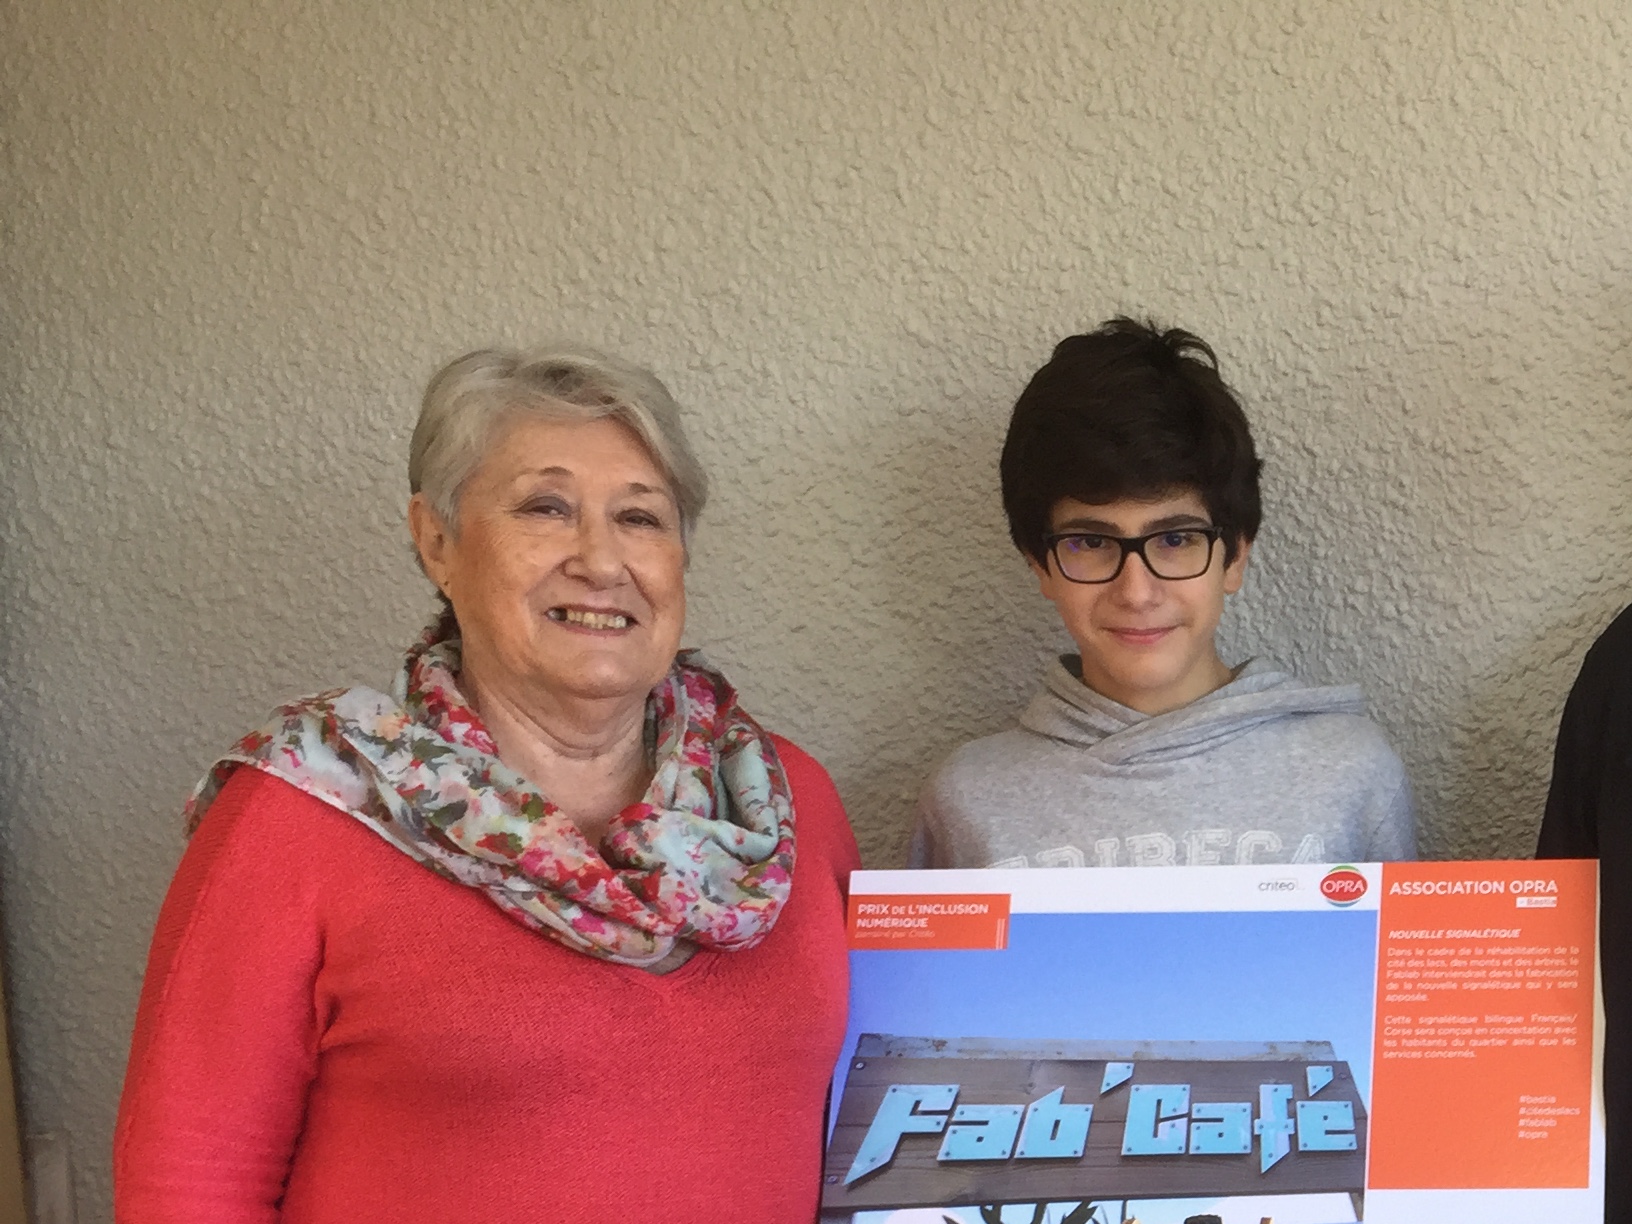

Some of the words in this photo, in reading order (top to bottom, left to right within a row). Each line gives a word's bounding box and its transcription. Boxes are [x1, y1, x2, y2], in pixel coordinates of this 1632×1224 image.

[986, 828, 1325, 868] IBECA
[1322, 880, 1365, 894] OPRA
[1389, 880, 1505, 896] ASSOCIATION
[1509, 880, 1558, 894] OPRA
[857, 904, 889, 915] PRIX
[908, 903, 989, 915] L'INCLUSION
[856, 917, 928, 928] NUMÉRIQUE
[1389, 930, 1444, 939] NOUVELLE
[1446, 928, 1521, 939] SIGNALÉTIQUE
[1387, 947, 1413, 957] Dans
[1415, 947, 1425, 956] le
[1427, 947, 1455, 956] cadre
[1458, 947, 1472, 956] de
[1487, 946, 1551, 955] réhabilitation
[1554, 946, 1567, 955] de
[1570, 945, 1579, 955] la
[1407, 959, 1425, 968] des
[1450, 958, 1468, 967] des
[1470, 959, 1501, 967] monts
[1502, 959, 1513, 967] et
[1515, 958, 1532, 967] des
[1569, 956, 1579, 966] le
[1386, 969, 1420, 979] Fablab
[1489, 969, 1513, 978] dans
[1514, 968, 1524, 978] la
[1526, 968, 1579, 978] fabrication
[1386, 982, 1399, 991] de
[1403, 981, 1413, 990] la
[1417, 981, 1458, 990] nouvelle
[1462, 981, 1521, 991] signalétique
[1525, 981, 1542, 990] qui
[1545, 981, 1554, 991] y
[1557, 981, 1578, 989] sera
[1384, 1015, 1412, 1025] Cette
[1418, 1014, 1478, 1026] signalétique
[1484, 1014, 1524, 1026] bilingue
[1384, 1026, 1413, 1036] Corse
[1414, 1027, 1436, 1036] sera
[1474, 1027, 1488, 1036] en
[1490, 1026, 1552, 1035] concertation
[1553, 1026, 1577, 1035] avec
[1383, 1038, 1398, 1047] les
[1401, 1038, 1448, 1047] habitants
[1451, 1038, 1466, 1047] du
[1469, 1038, 1509, 1048] quartier
[1512, 1037, 1536, 1046] ainsi
[1538, 1038, 1559, 1047] que
[1562, 1036, 1577, 1046] les
[1383, 1050, 1423, 1059] services
